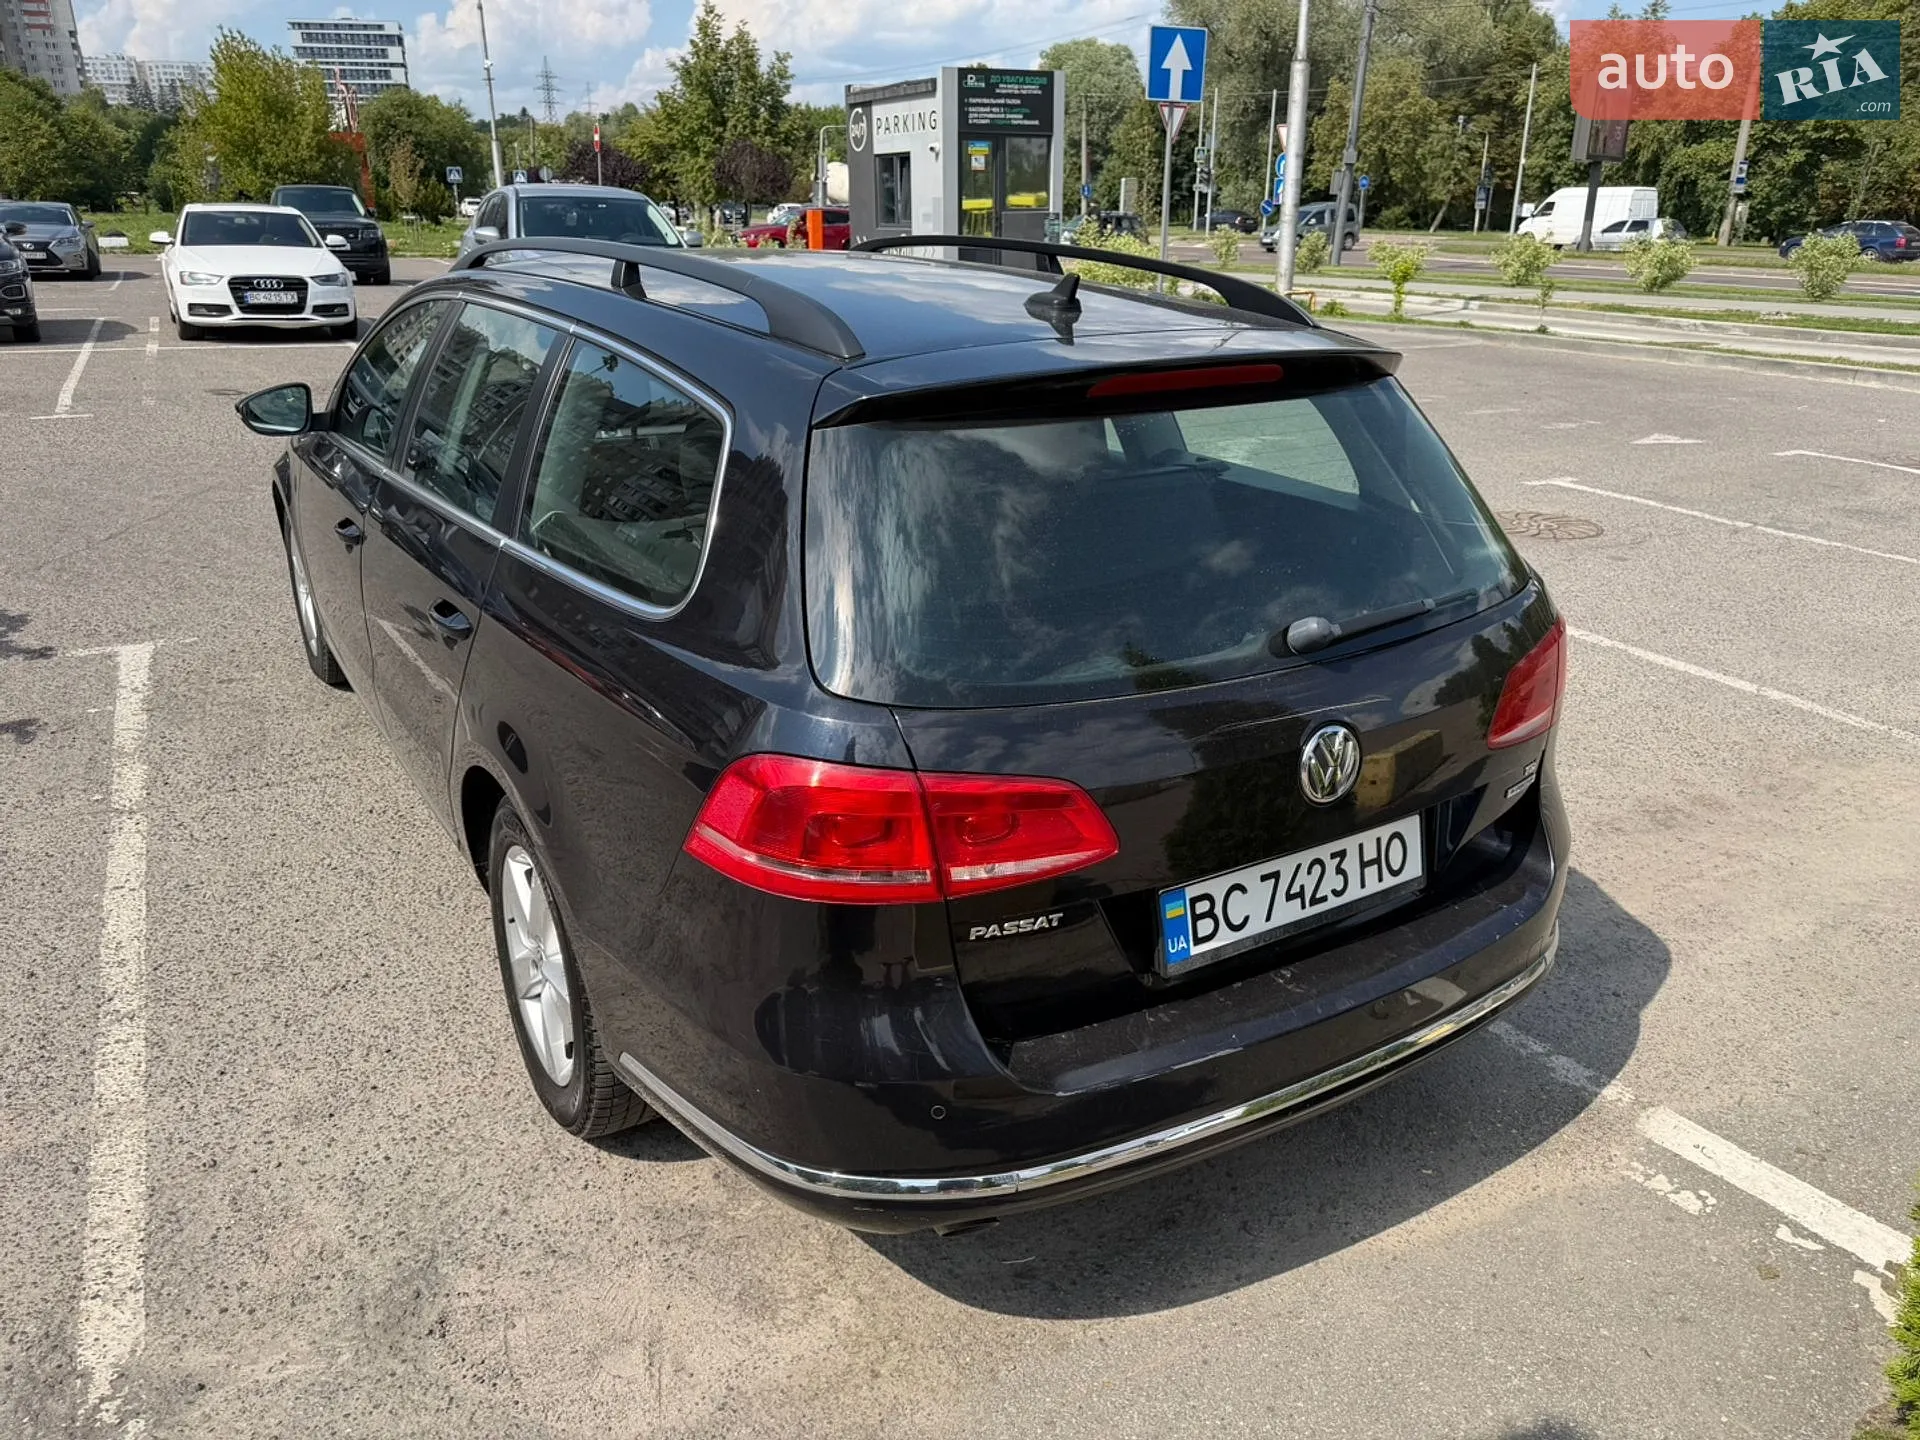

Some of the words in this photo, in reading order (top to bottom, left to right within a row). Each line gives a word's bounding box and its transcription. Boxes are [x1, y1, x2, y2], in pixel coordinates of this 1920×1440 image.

[990, 75, 1001, 83] ДО
[1002, 75, 1024, 83] УВАГИ
[851, 122, 866, 138] 24/7
[876, 110, 938, 136] PARKING
[1189, 882, 1250, 947] BC
[1260, 848, 1350, 923] 7423
[1358, 831, 1408, 889] HO
[969, 912, 1064, 940] PASSAT
[1168, 936, 1188, 953] UA
